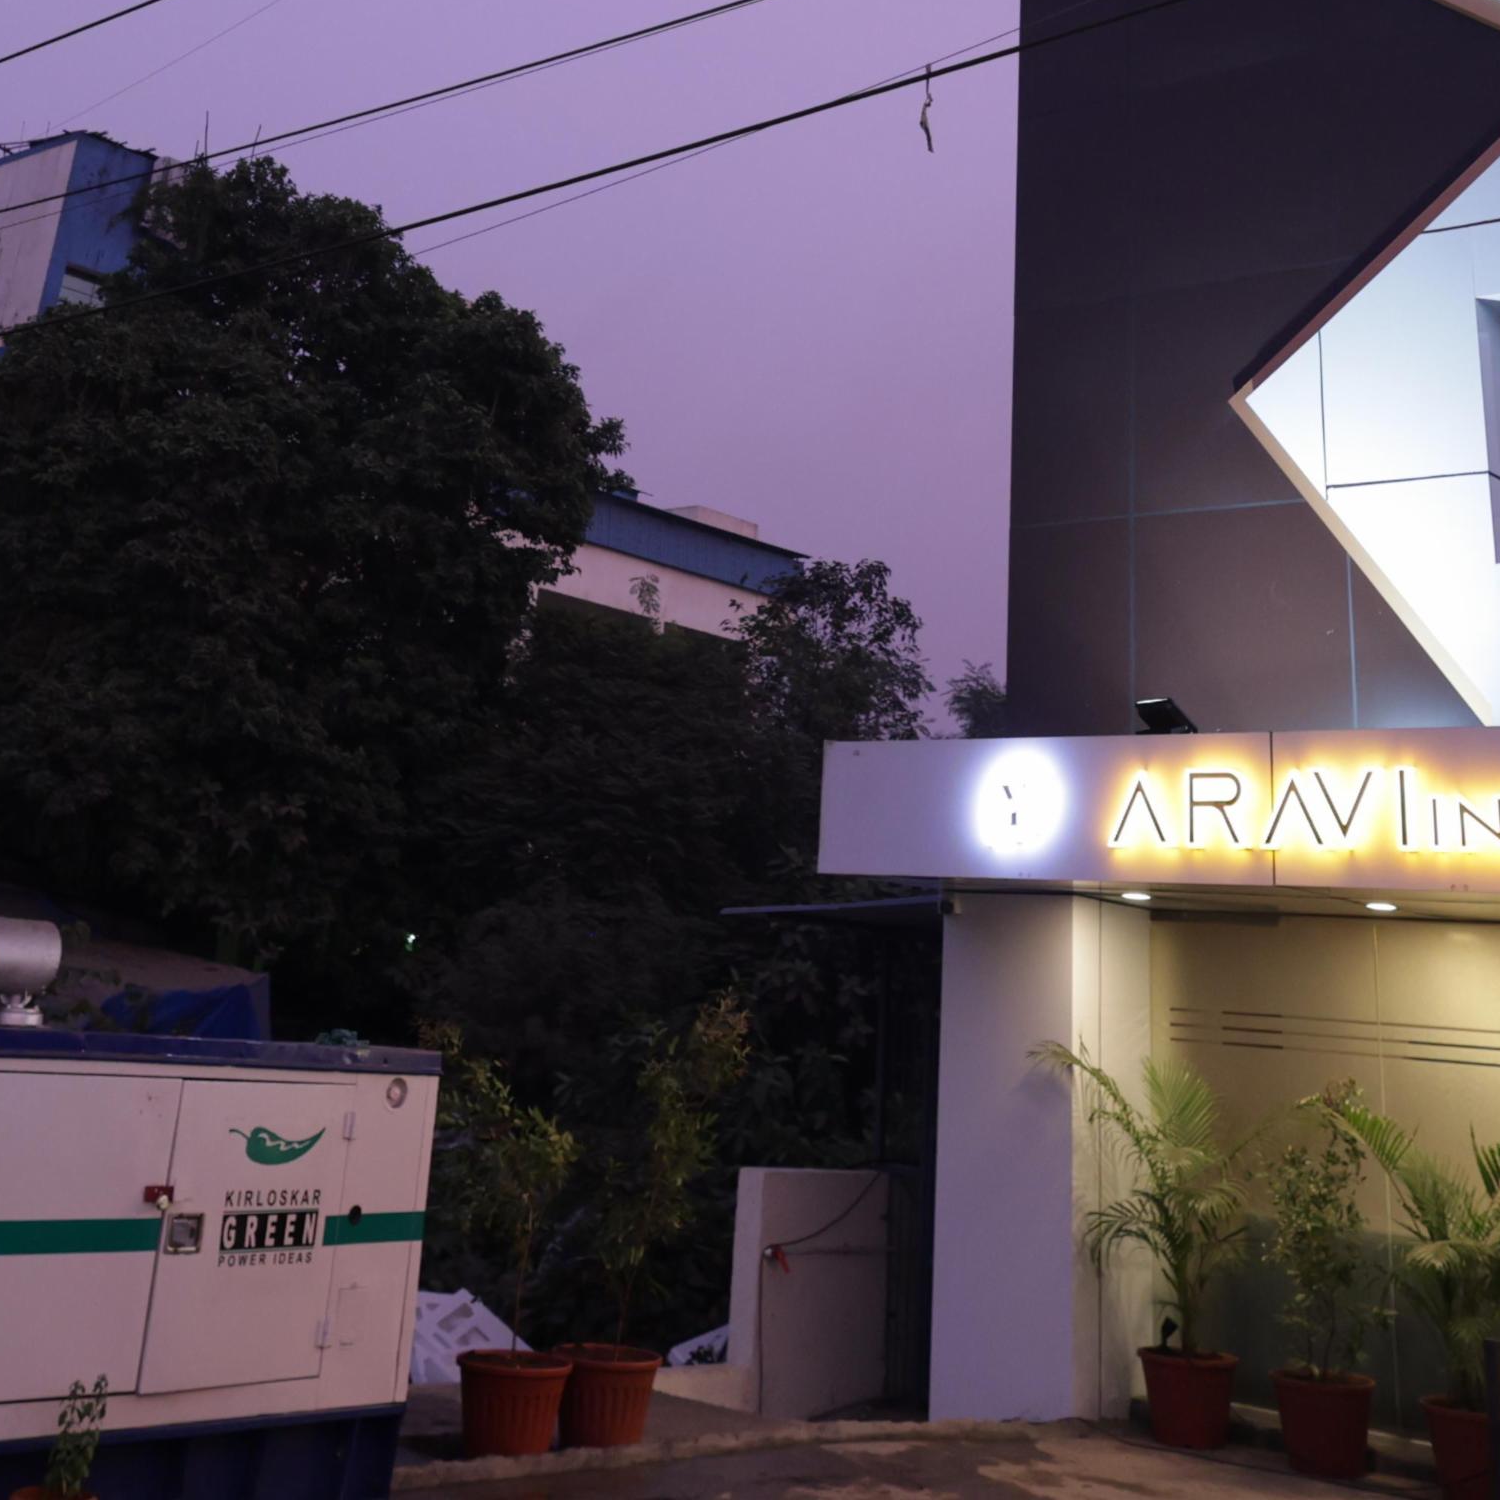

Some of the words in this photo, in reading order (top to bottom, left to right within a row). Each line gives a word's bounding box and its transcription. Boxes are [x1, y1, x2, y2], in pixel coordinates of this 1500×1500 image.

[1109, 767, 1414, 850] ARAVI
[225, 1189, 321, 1208] KIRLOSKAR
[222, 1213, 317, 1249] GREEN
[218, 1253, 267, 1268] POWER
[272, 1251, 313, 1266] IDEAS
